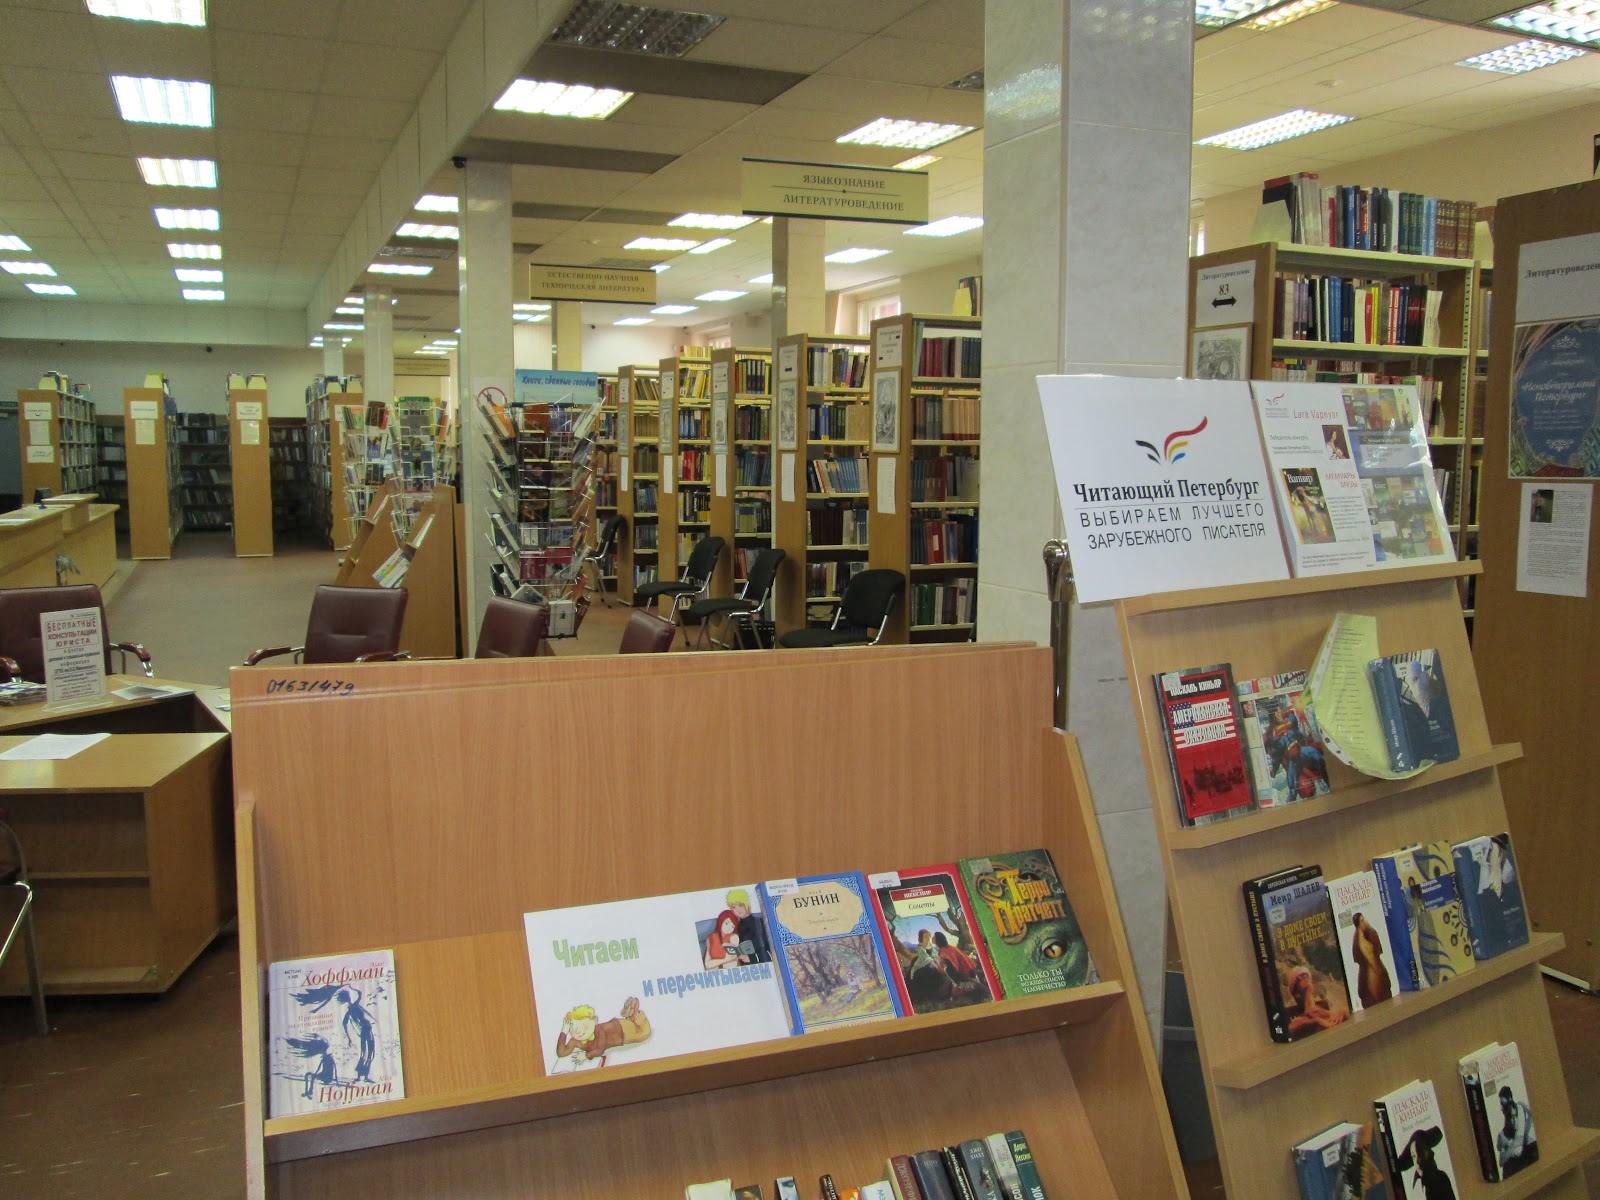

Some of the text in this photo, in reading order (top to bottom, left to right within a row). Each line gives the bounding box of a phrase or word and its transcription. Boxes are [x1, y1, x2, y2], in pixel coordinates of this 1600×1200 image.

[803, 174, 886, 190] ЯЗЫКОЗНАНИЕ
[783, 194, 905, 212] ЛИТЕРАТУРОВЕДЕНИЕ
[541, 282, 645, 293] ТЕХНИЧЕСКАЯ ЛИТЕРАТУРА
[1219, 284, 1229, 296] 83
[1293, 410, 1309, 419] Lara
[1310, 409, 1338, 421] Vapnyar
[1073, 478, 1260, 504] Читающий Петербург
[1080, 503, 1265, 528] ВЫБИРАЕМ ЛУЧШЕГО
[1087, 523, 1266, 550] ЗАРУБЕЖНОГО ПИСАТЕЛЯ
[47, 618, 96, 632] БЕСПЛАТНЫЕ
[48, 629, 97, 640] КОНСУЛЬТАЦИИ
[56, 638, 90, 647] ЮРИСТА
[1199, 679, 1222, 691] КИНЬЯР
[1172, 702, 1232, 725] АМЕРИКАНСКАЯ
[904, 890, 932, 898] ШЕКСПИР
[996, 868, 1052, 905] Терри
[1270, 881, 1321, 906] Меир ШАЛЕВ
[1337, 879, 1372, 897] ПАСКАЛЬ
[793, 893, 840, 908] БУНИН
[908, 902, 935, 910] Сонеты
[1340, 889, 1371, 906] КИНЬЯР
[990, 899, 1067, 936] Пратчетт
[1277, 911, 1327, 938] В ДОМЕ СВОЕМ
[552, 938, 639, 968] Читаем
[1280, 940, 1285, 951] В
[301, 966, 384, 989] Хоффман
[643, 963, 772, 998] и перечитываем
[1019, 968, 1063, 982] ТОЛЬКО ТЫ
[1022, 981, 1067, 994] ЧЕЛОВЕЧЕСТВО
[319, 1081, 393, 1104] Hoffman
[1394, 1091, 1429, 1114] ПАСКАЛЬ
[1399, 1102, 1429, 1124] КИНЬЯР
[1013, 1143, 1027, 1152] Дорис
